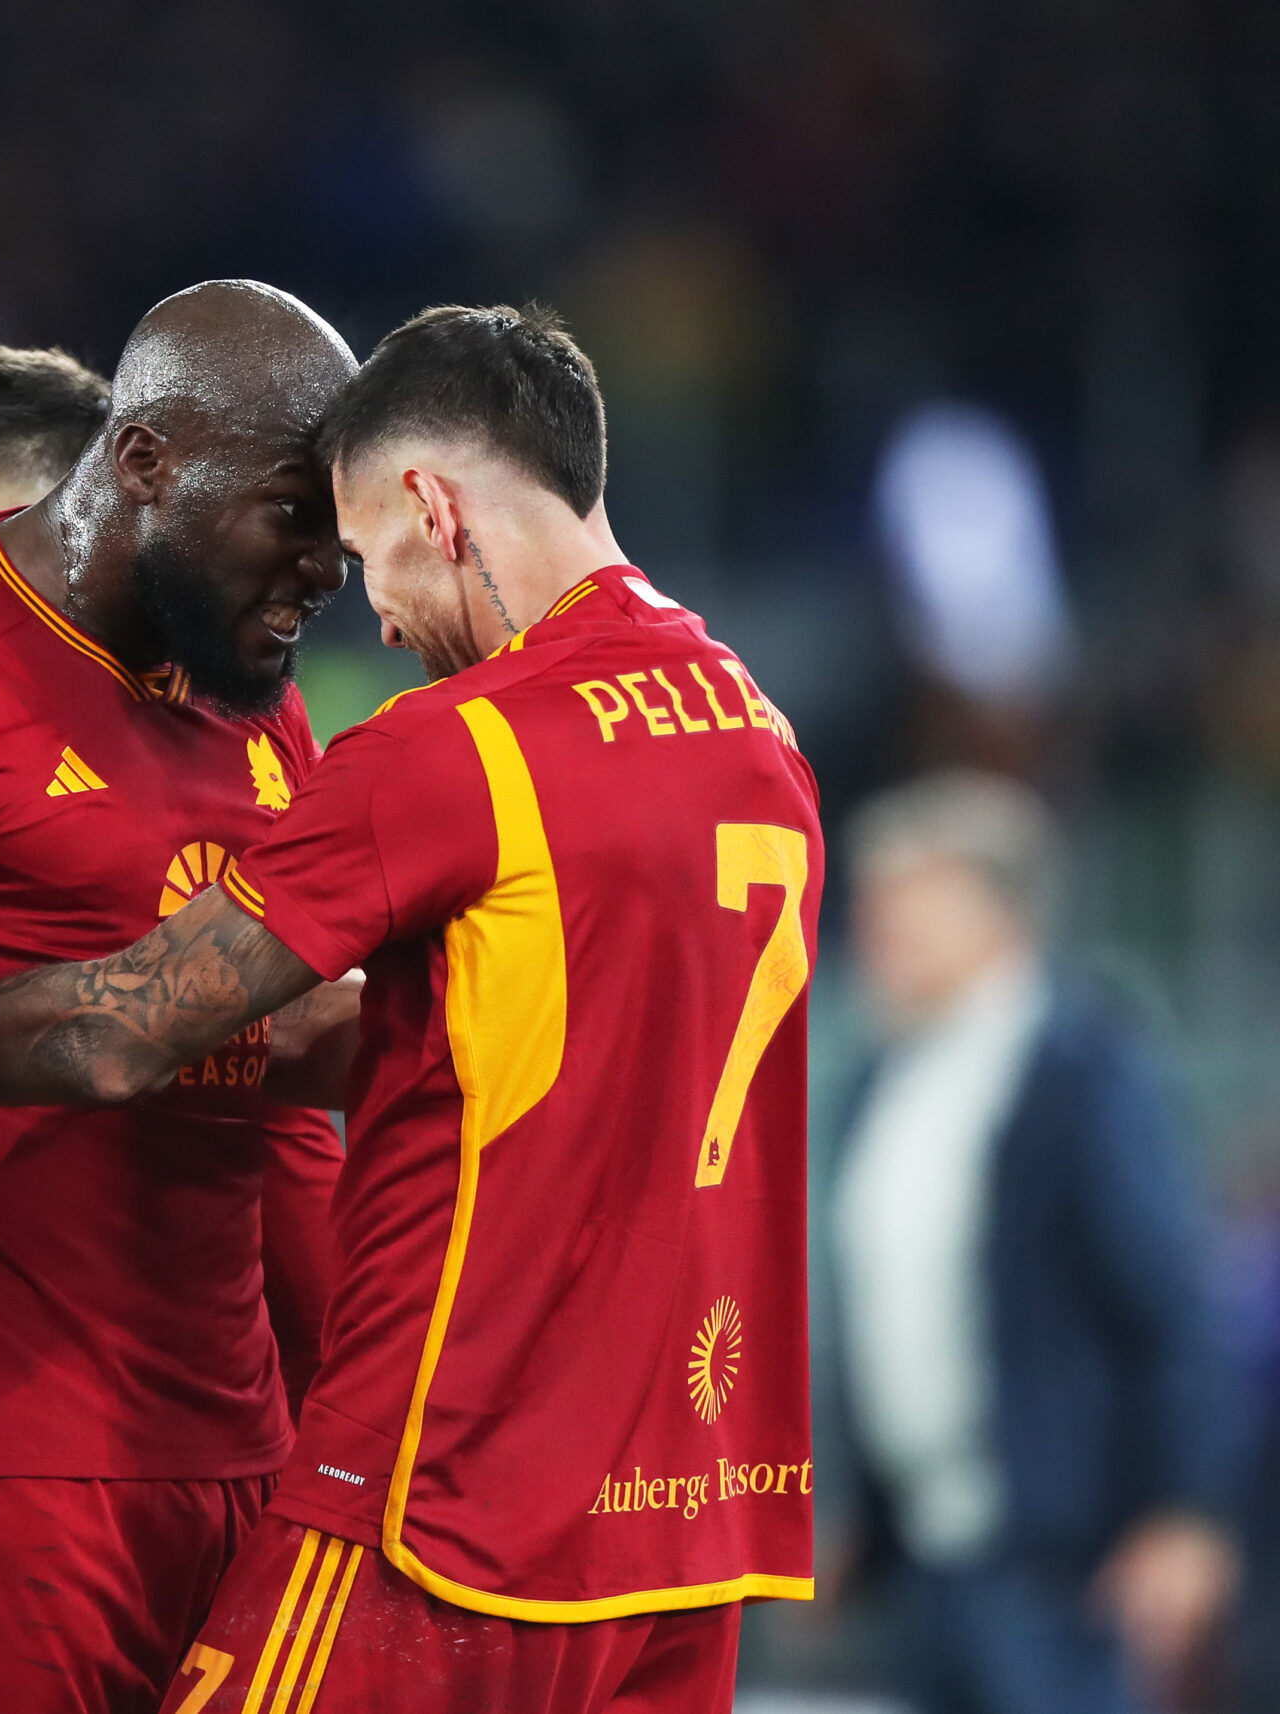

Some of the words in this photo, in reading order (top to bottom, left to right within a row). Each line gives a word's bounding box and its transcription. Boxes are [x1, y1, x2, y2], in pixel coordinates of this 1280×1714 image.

[694, 823, 809, 1189] 7
[317, 1463, 366, 1486] AEROREADY
[587, 1466, 710, 1520] Auberge
[716, 1457, 813, 1502] Resort
[174, 1641, 235, 1714] 7
